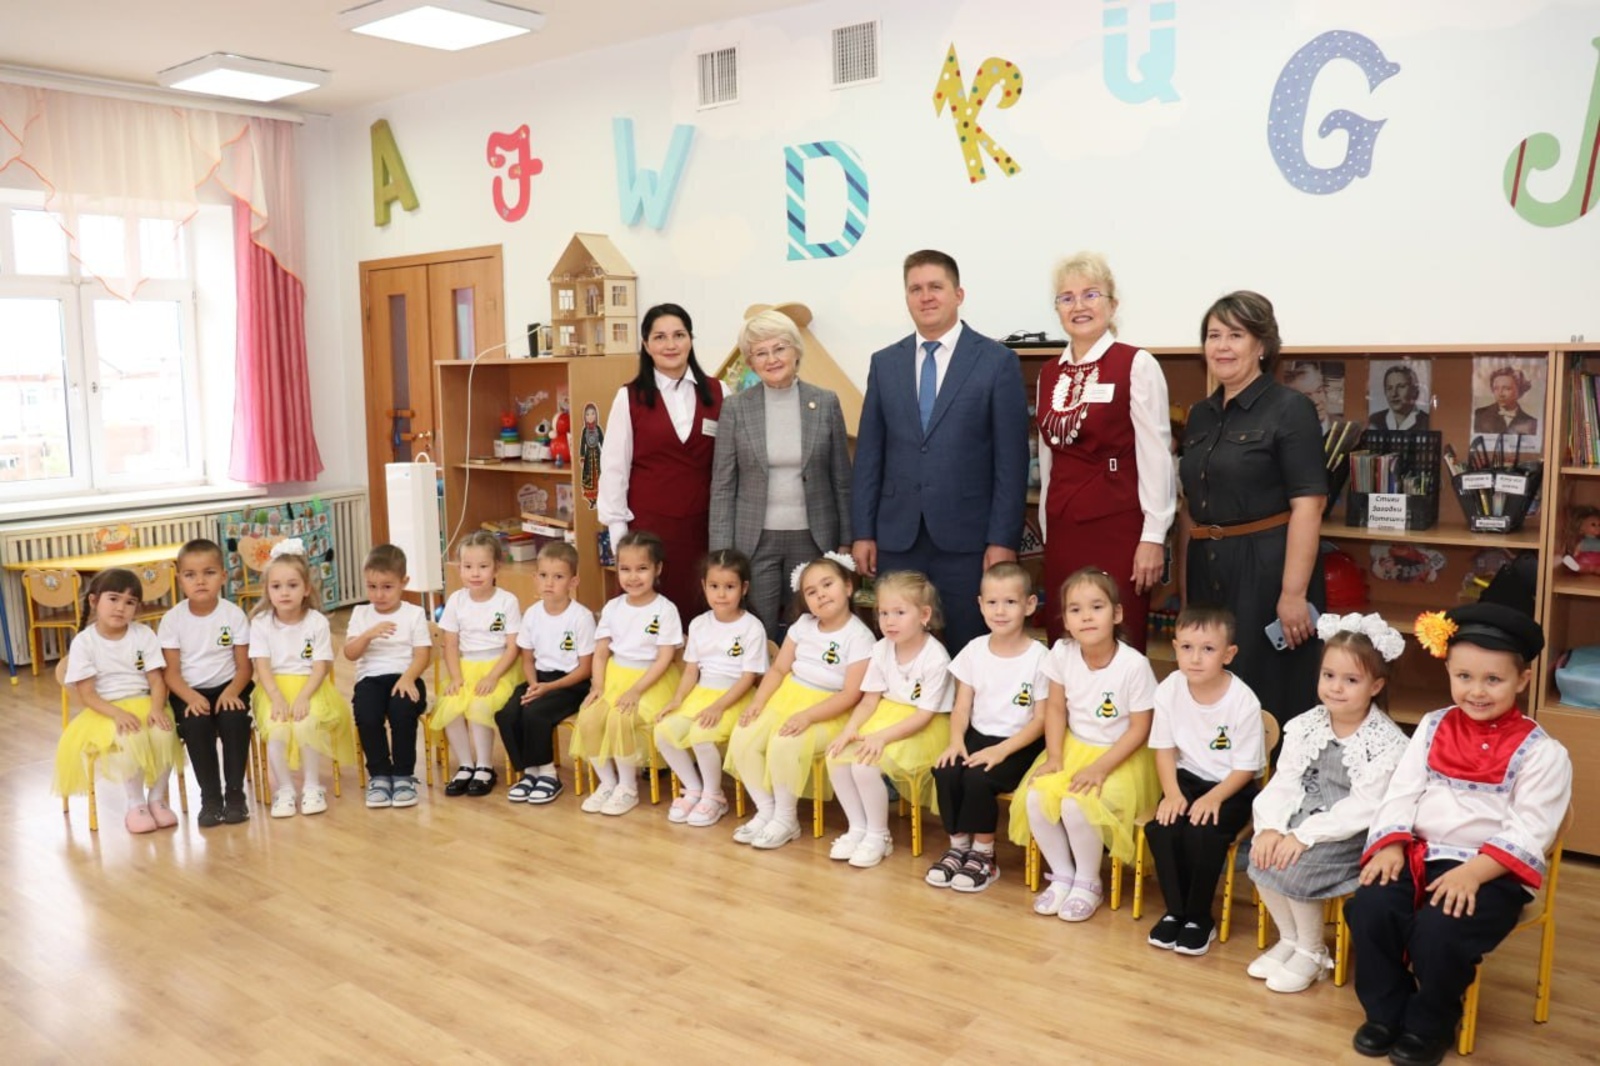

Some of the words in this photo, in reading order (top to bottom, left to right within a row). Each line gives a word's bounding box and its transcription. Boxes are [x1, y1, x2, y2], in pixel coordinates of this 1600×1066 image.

[612, 117, 695, 230] W
[933, 41, 1023, 184] K
[1266, 29, 1400, 195] G
[783, 140, 869, 261] D
